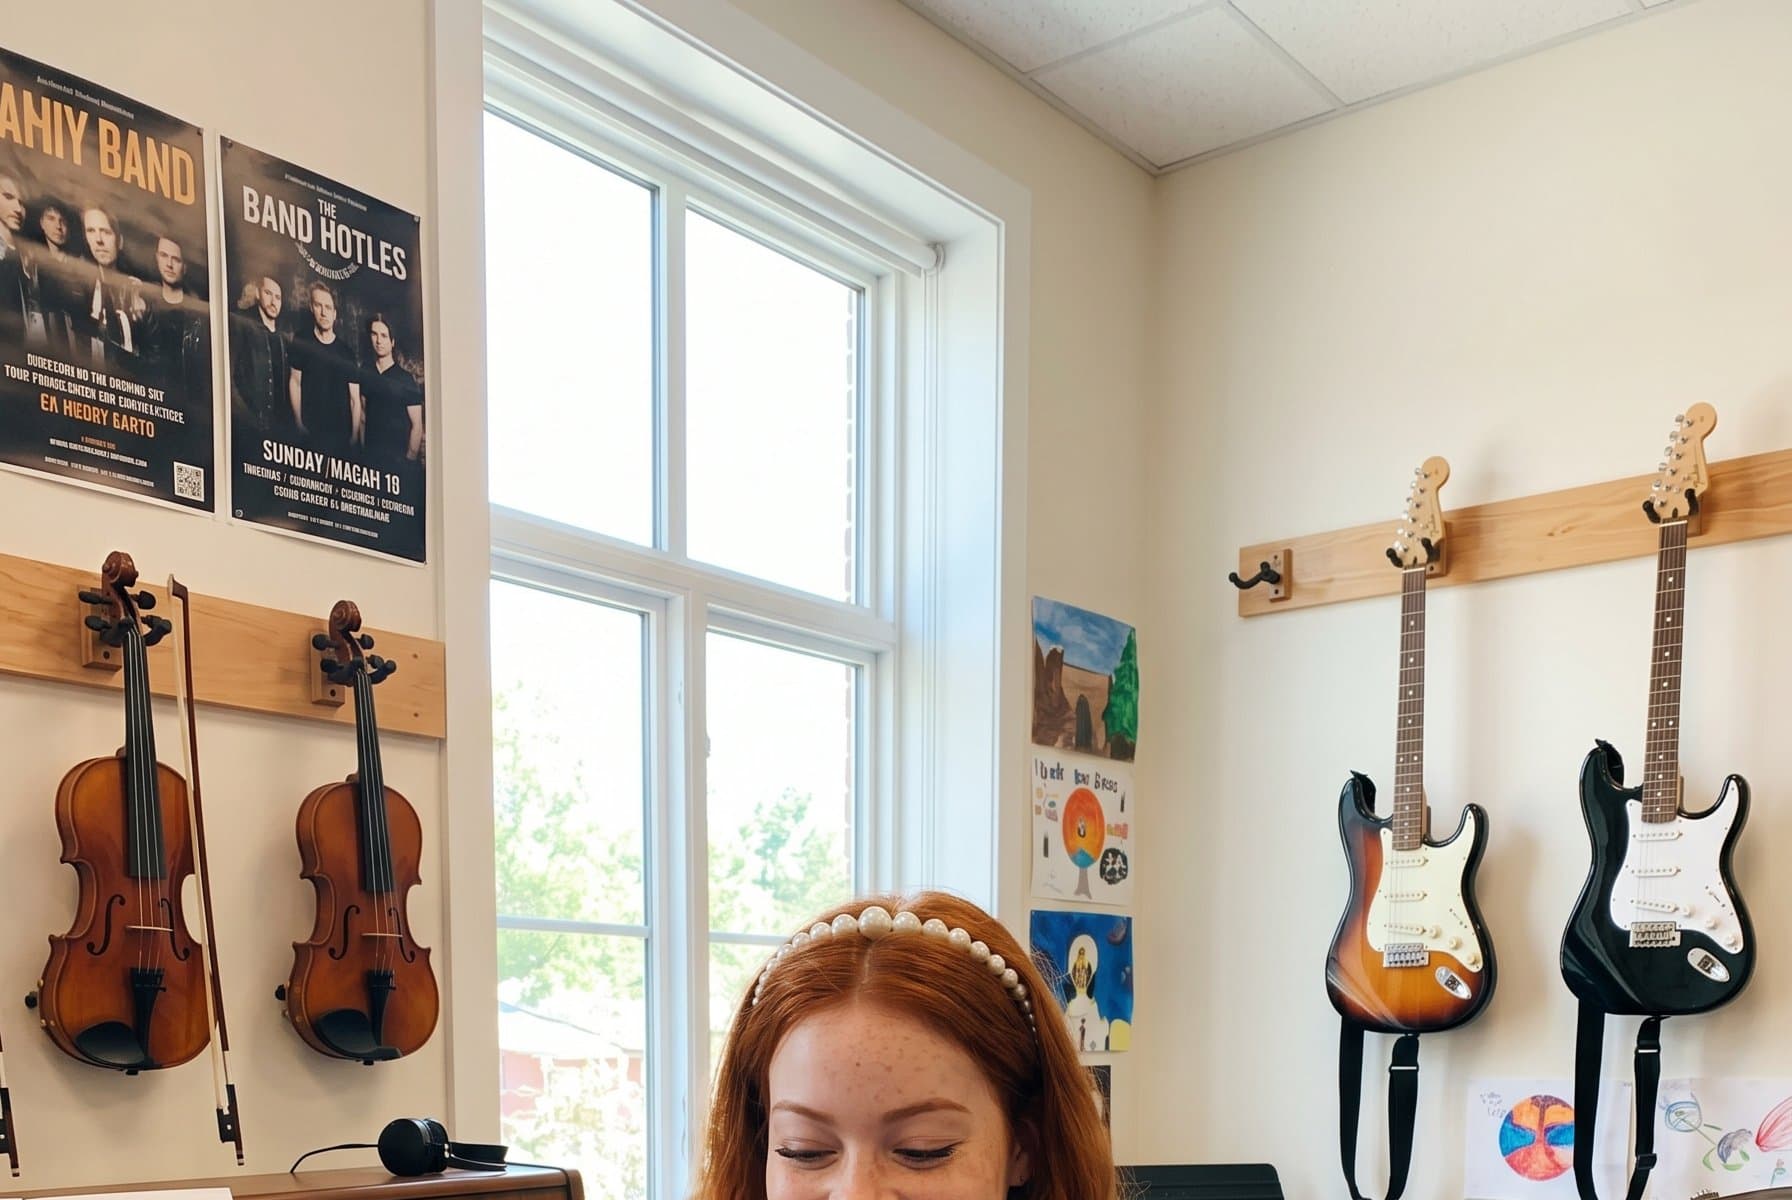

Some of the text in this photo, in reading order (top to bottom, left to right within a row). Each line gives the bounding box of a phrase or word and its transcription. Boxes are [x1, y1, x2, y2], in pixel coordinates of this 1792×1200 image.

[98, 117, 195, 206] BAND
[242, 185, 313, 244] BAND
[320, 217, 407, 281] HOTLES
[317, 199, 337, 219] THE
[263, 439, 324, 474] SUNDAY
